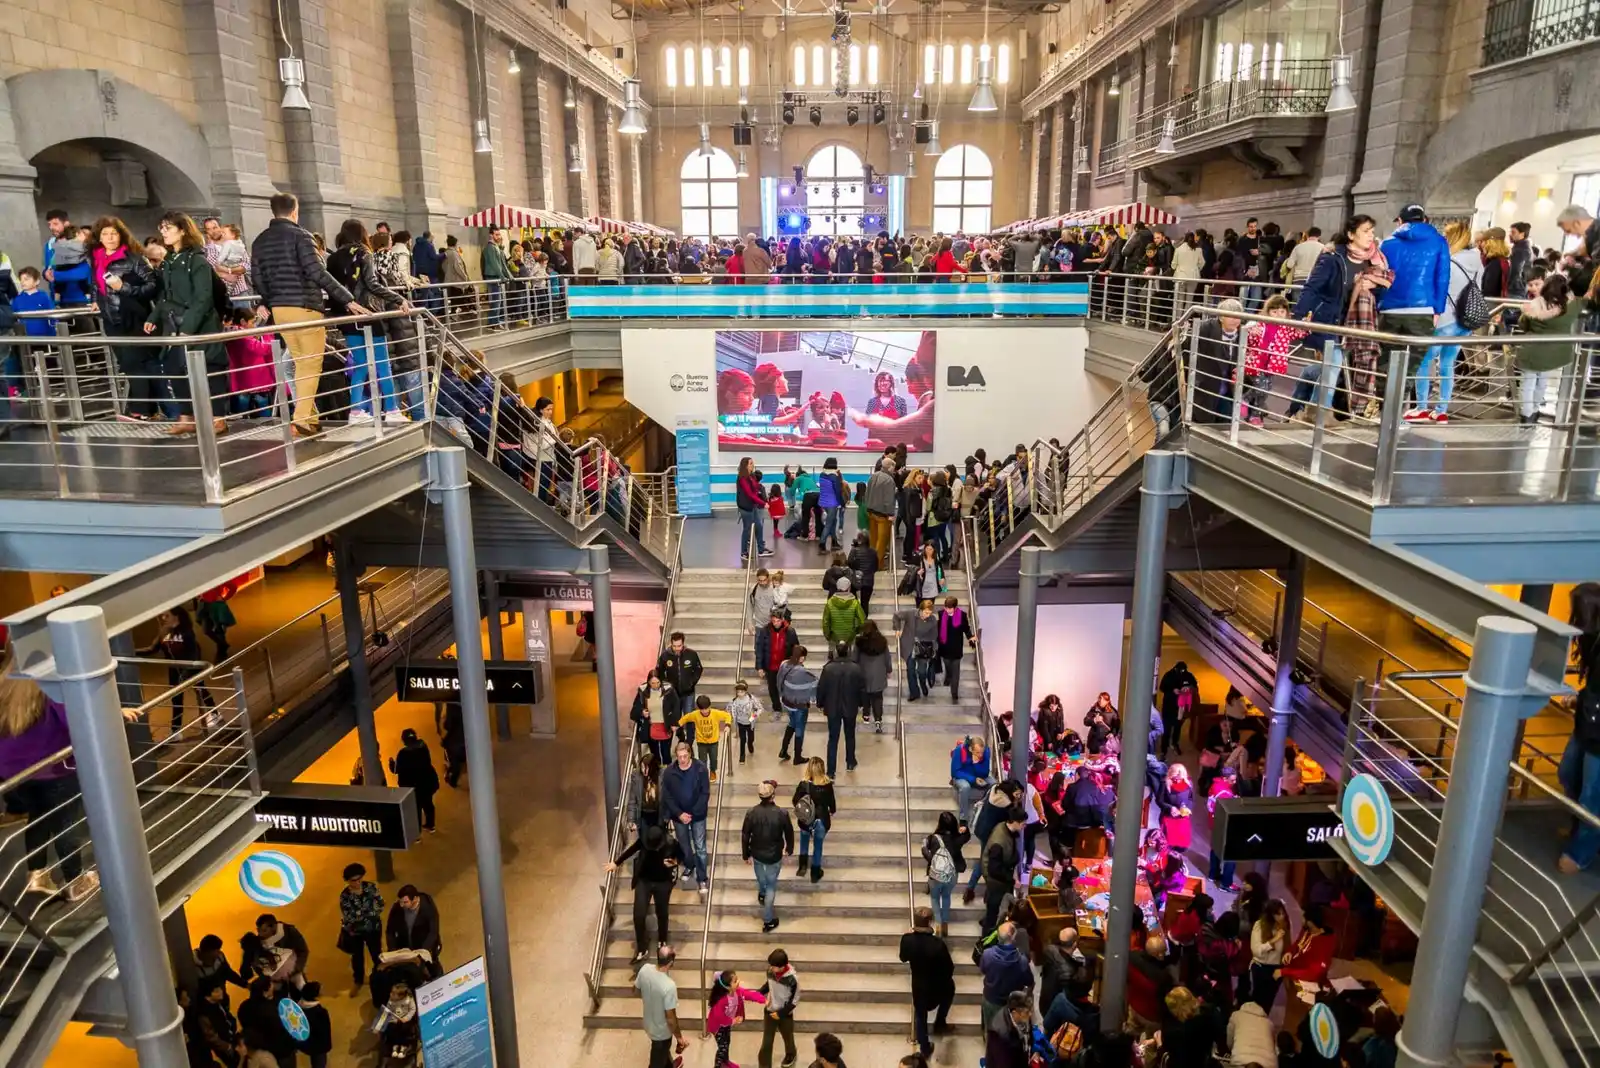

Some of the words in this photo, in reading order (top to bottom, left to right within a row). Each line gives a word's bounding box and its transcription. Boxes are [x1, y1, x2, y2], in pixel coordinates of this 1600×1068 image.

[544, 588, 556, 598] LA
[559, 587, 593, 599] GALER
[410, 677, 434, 689] SALA
[437, 678, 450, 689] DE
[312, 816, 382, 834] AUDITORIO
[1306, 823, 1344, 842] SALÓ
